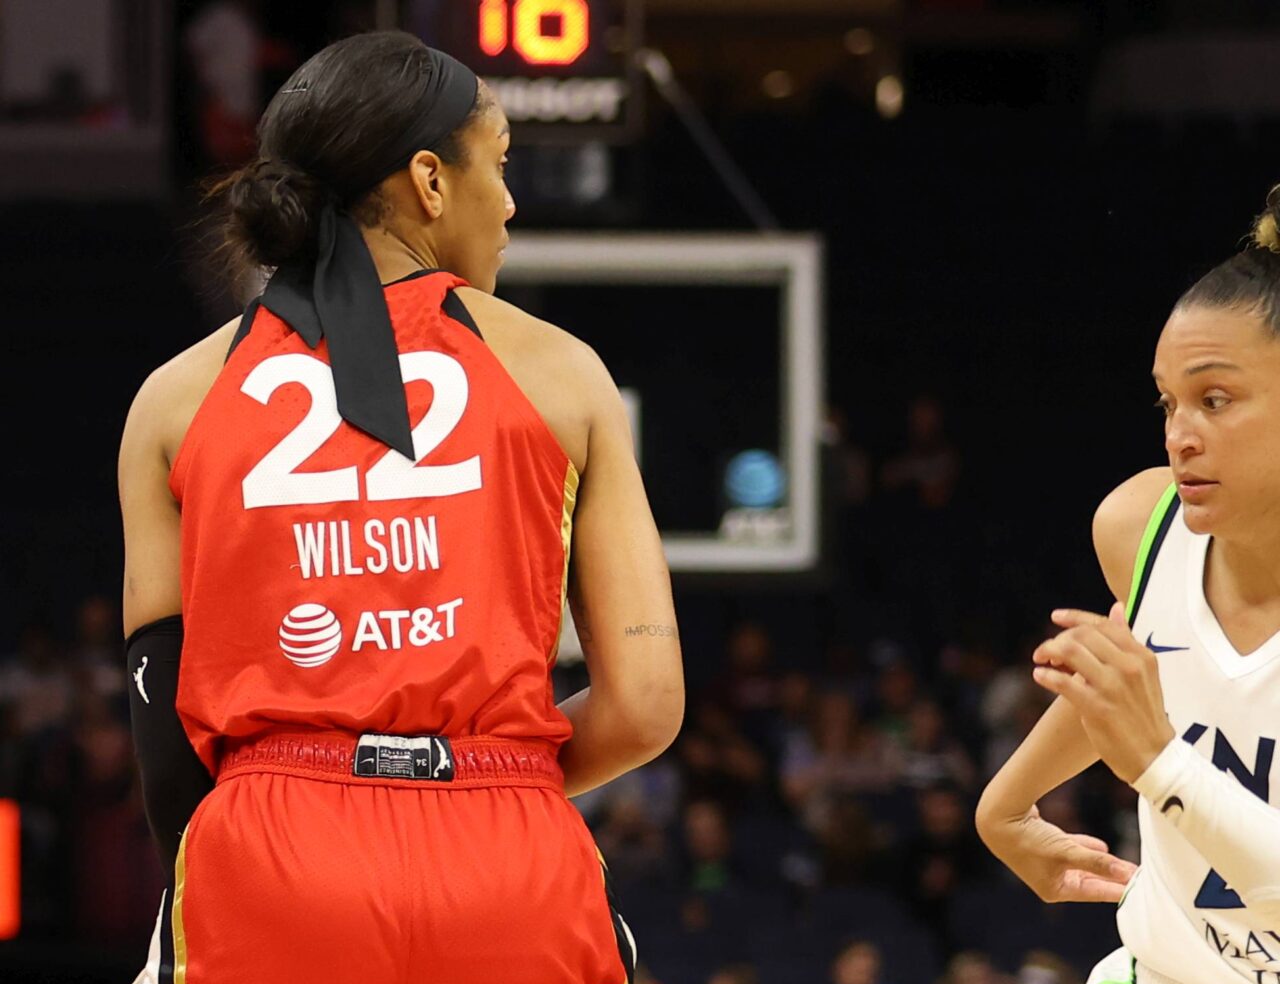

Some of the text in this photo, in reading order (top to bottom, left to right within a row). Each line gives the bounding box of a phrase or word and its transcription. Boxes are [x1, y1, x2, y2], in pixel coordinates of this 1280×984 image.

[240, 352, 482, 509] 22
[293, 515, 440, 579] WILSON
[352, 597, 464, 652] AT&T
